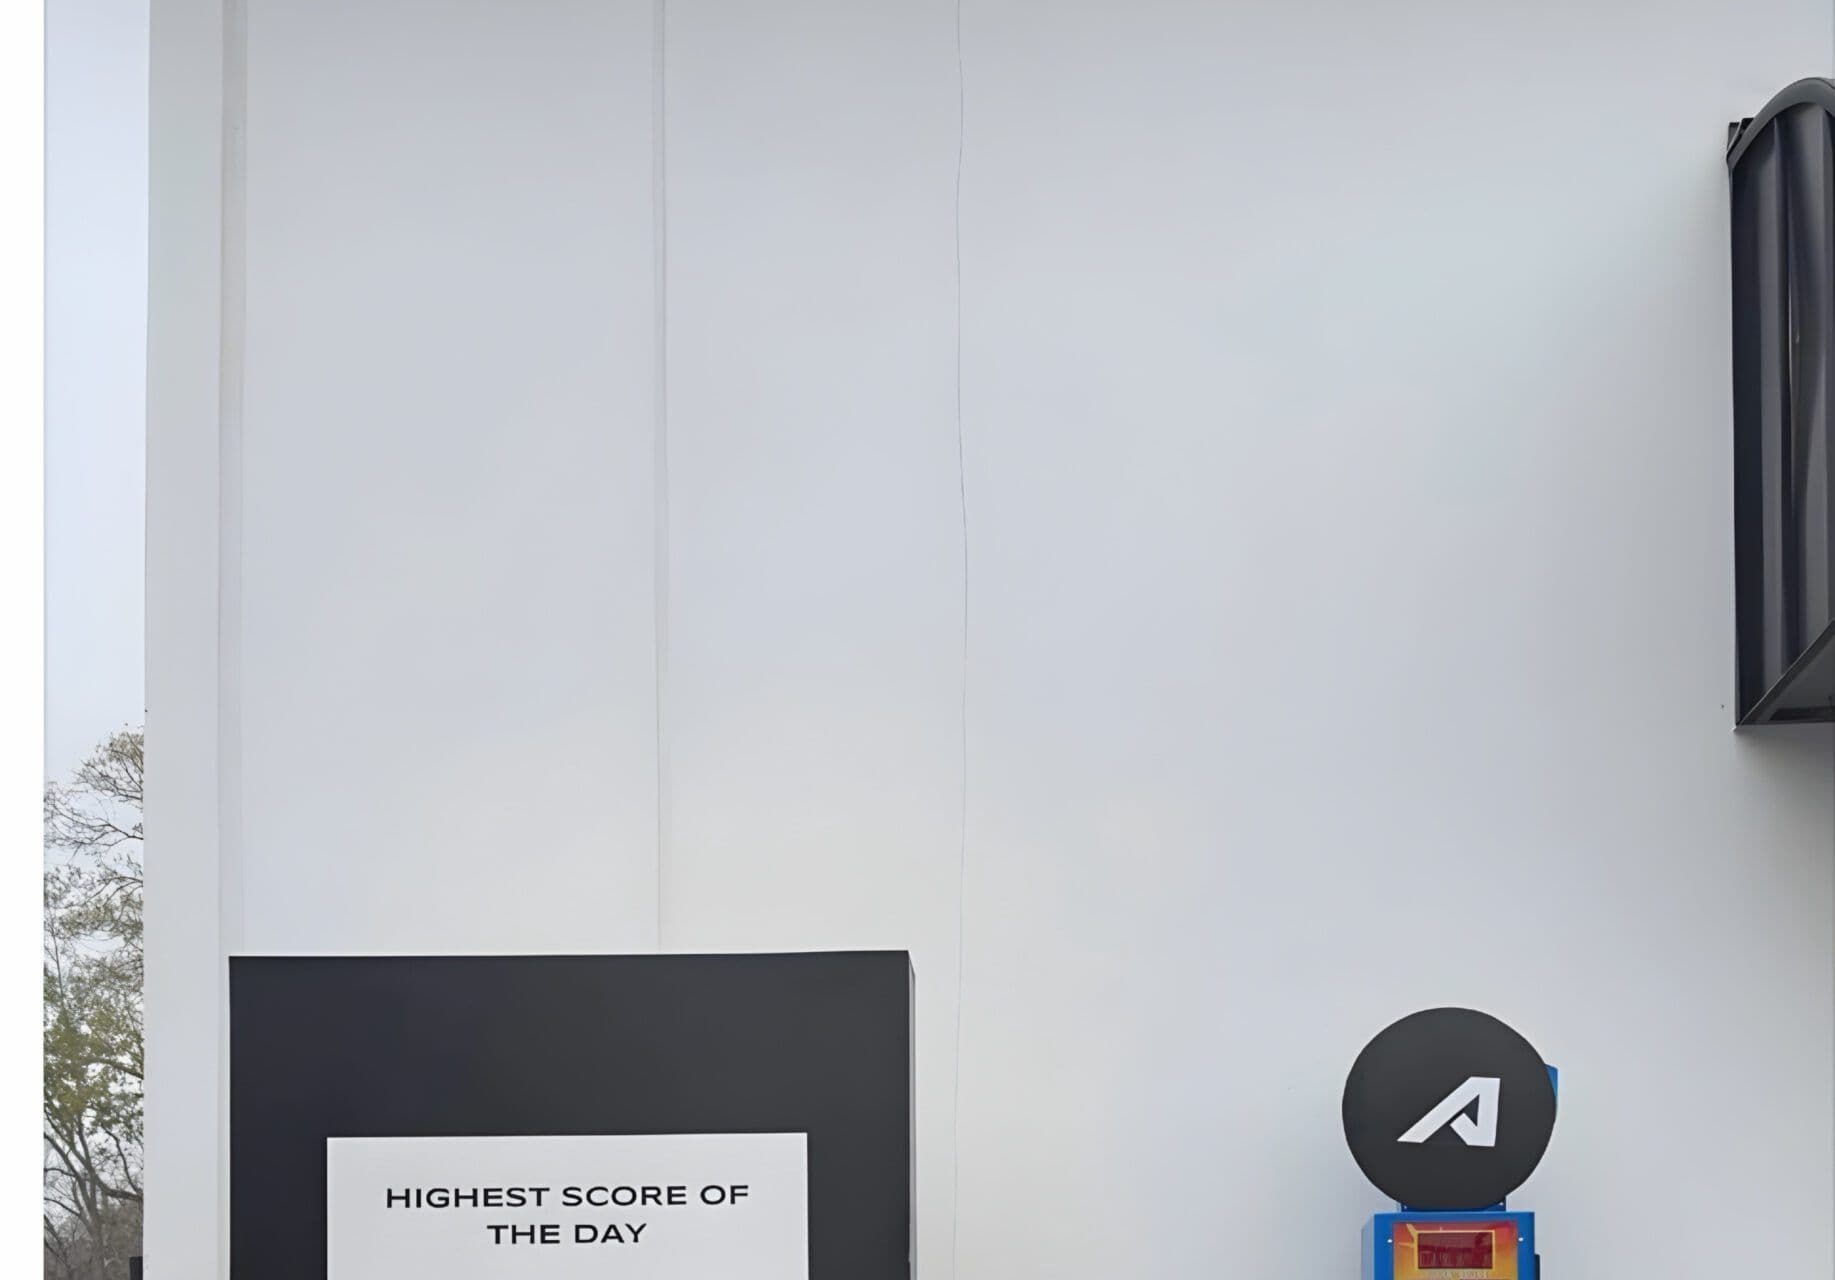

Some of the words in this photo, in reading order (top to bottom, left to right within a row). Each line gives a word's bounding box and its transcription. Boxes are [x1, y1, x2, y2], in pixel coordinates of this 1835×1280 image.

[386, 1187, 551, 1209] HIGHEST
[562, 1185, 687, 1207] SCORE
[699, 1184, 750, 1206] OF
[486, 1224, 561, 1245] THE
[574, 1223, 647, 1244] DAY
